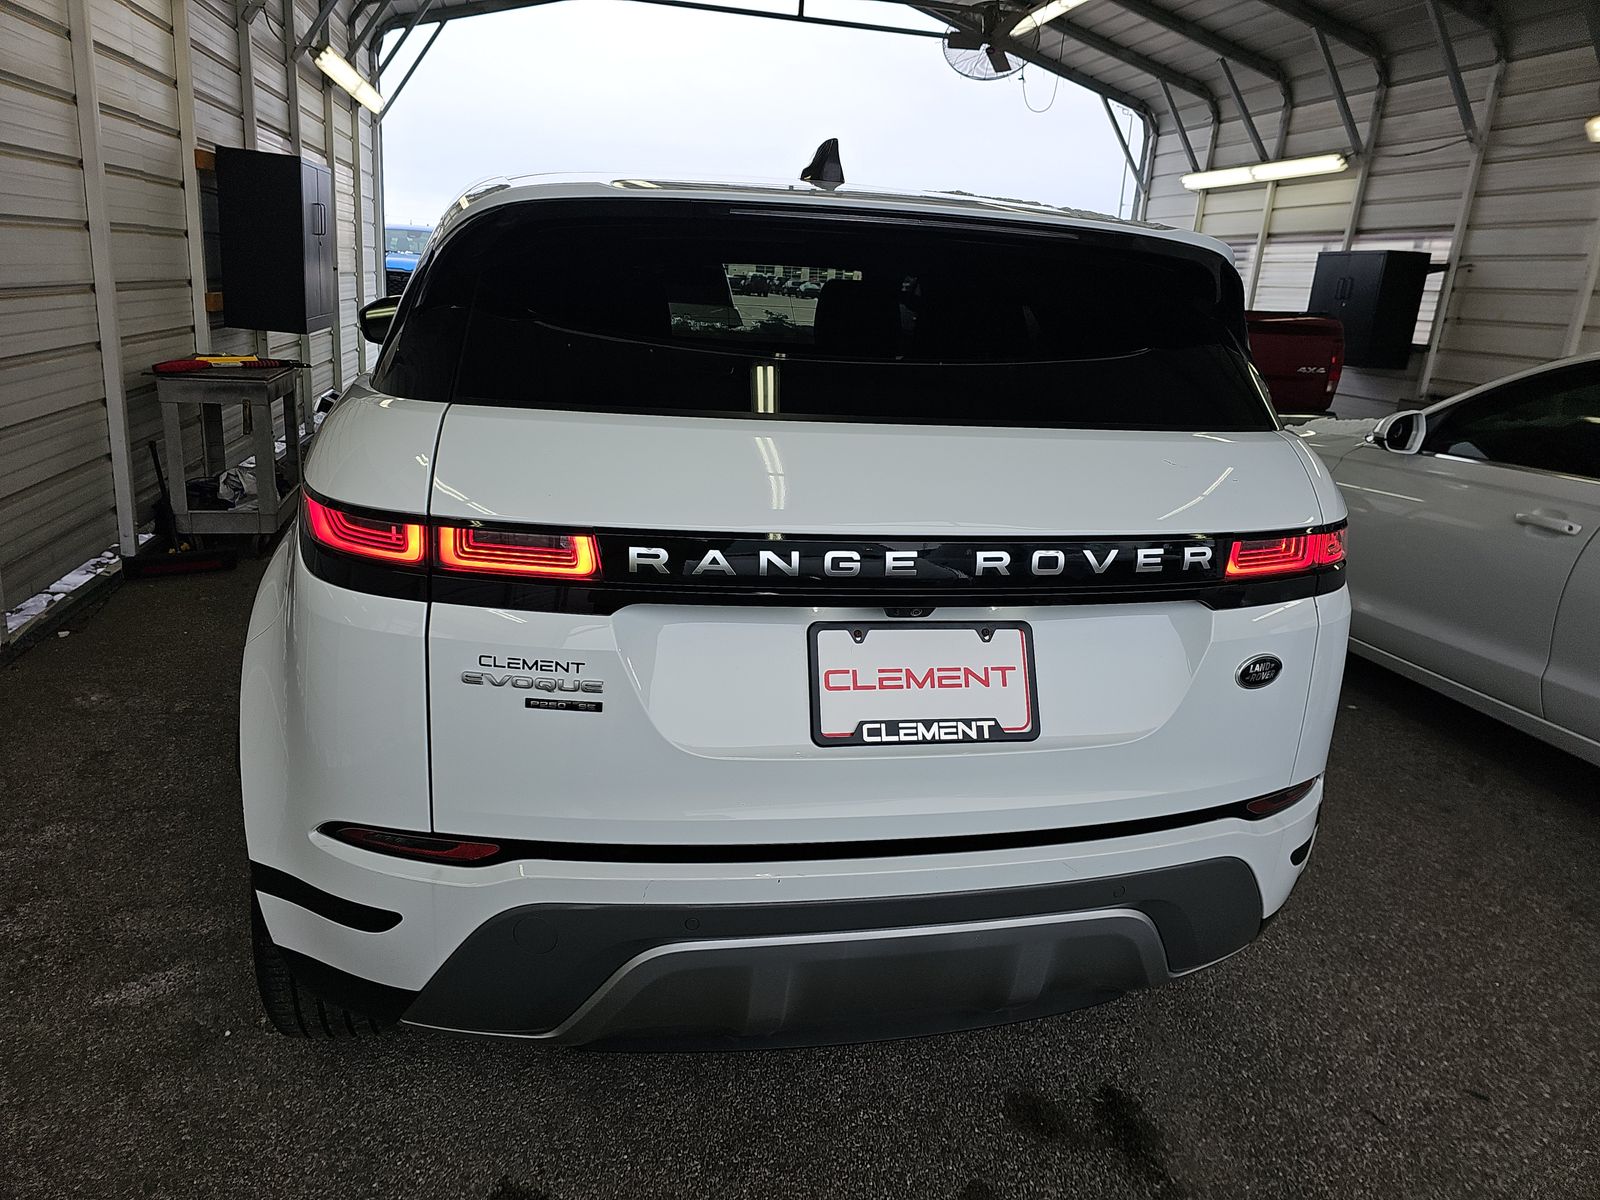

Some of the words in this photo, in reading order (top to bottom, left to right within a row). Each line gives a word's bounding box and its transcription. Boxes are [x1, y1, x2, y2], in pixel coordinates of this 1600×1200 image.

[628, 546, 918, 577] RANGE
[975, 546, 1213, 576] ROVER
[478, 655, 586, 674] CLEMENT
[1249, 662, 1271, 673] LAND
[1249, 669, 1276, 682] ROVER
[461, 671, 603, 693] EVOQUE
[824, 666, 1016, 691] CLEMENT
[862, 720, 995, 743] CLEMENT
